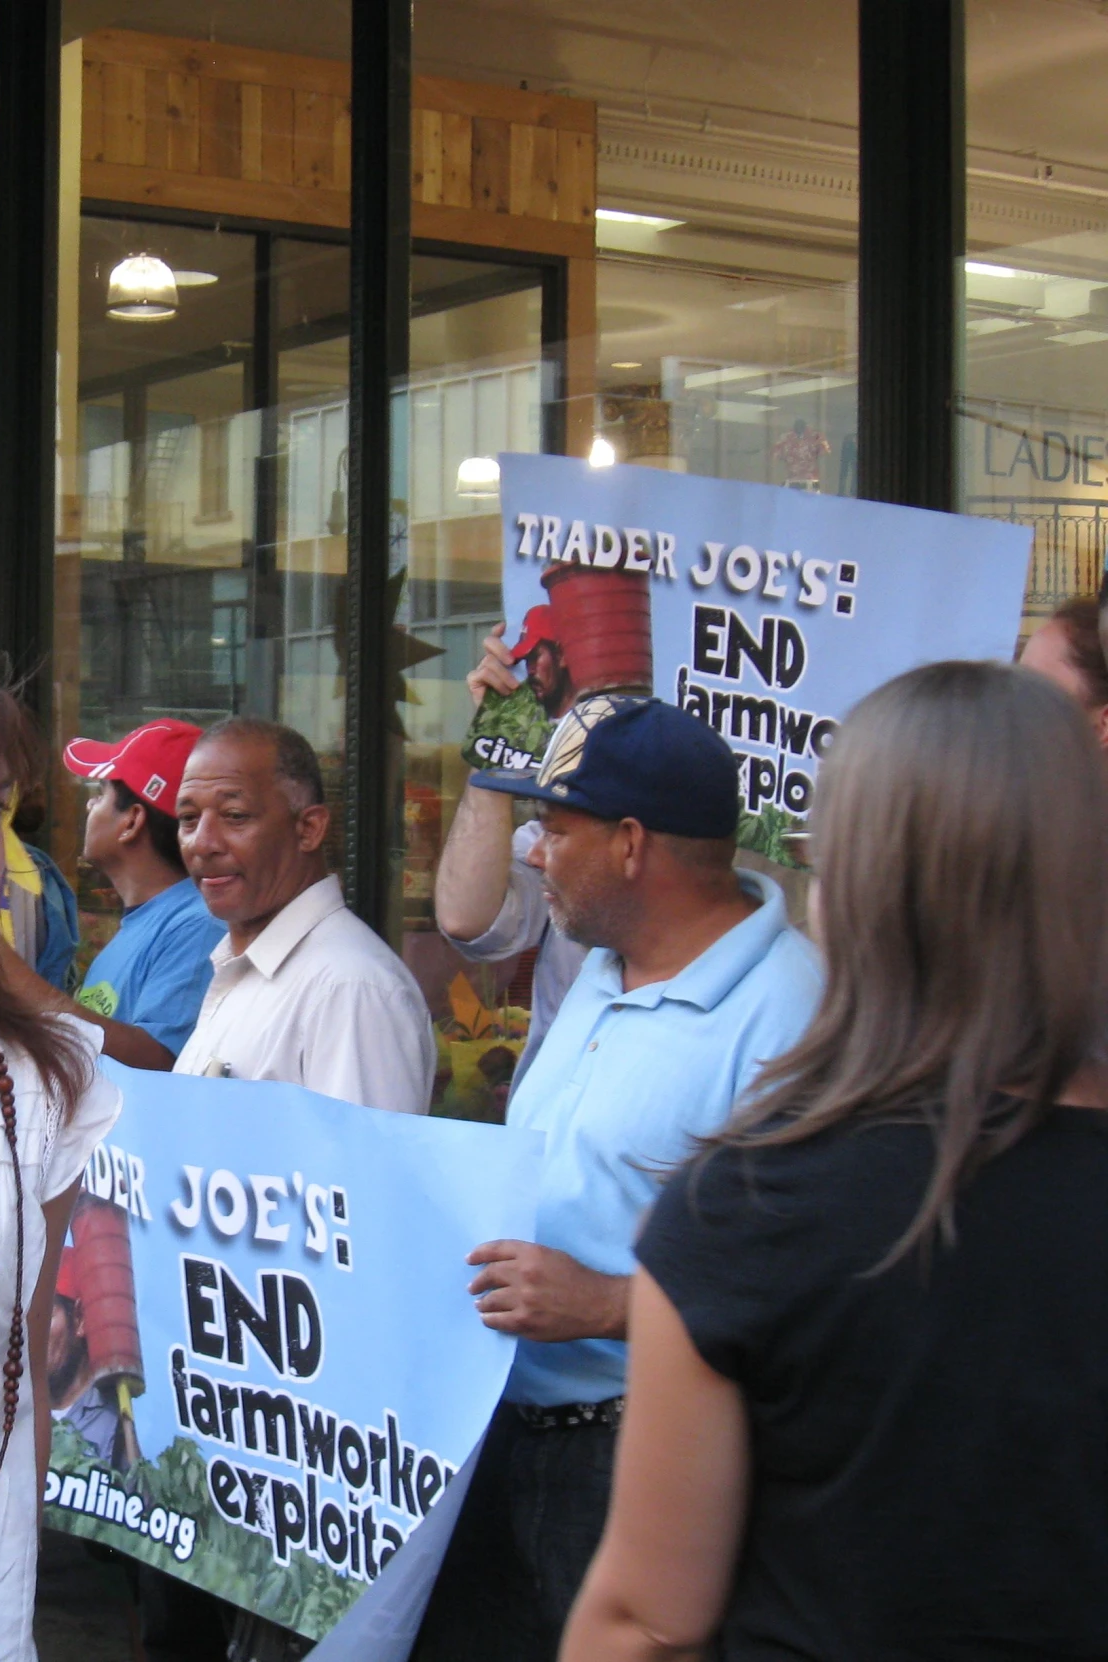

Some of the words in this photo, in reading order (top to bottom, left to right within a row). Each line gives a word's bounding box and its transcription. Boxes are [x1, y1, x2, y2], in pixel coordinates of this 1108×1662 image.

[984, 422, 1108, 487] LADIE
[517, 512, 678, 580] TRADER
[690, 541, 859, 619] JOE'S:
[693, 603, 807, 691] END
[170, 1163, 352, 1272] JOE'S:
[181, 1253, 325, 1382] END
[170, 1346, 457, 1519] farmworke
[44, 1469, 196, 1560] online.org
